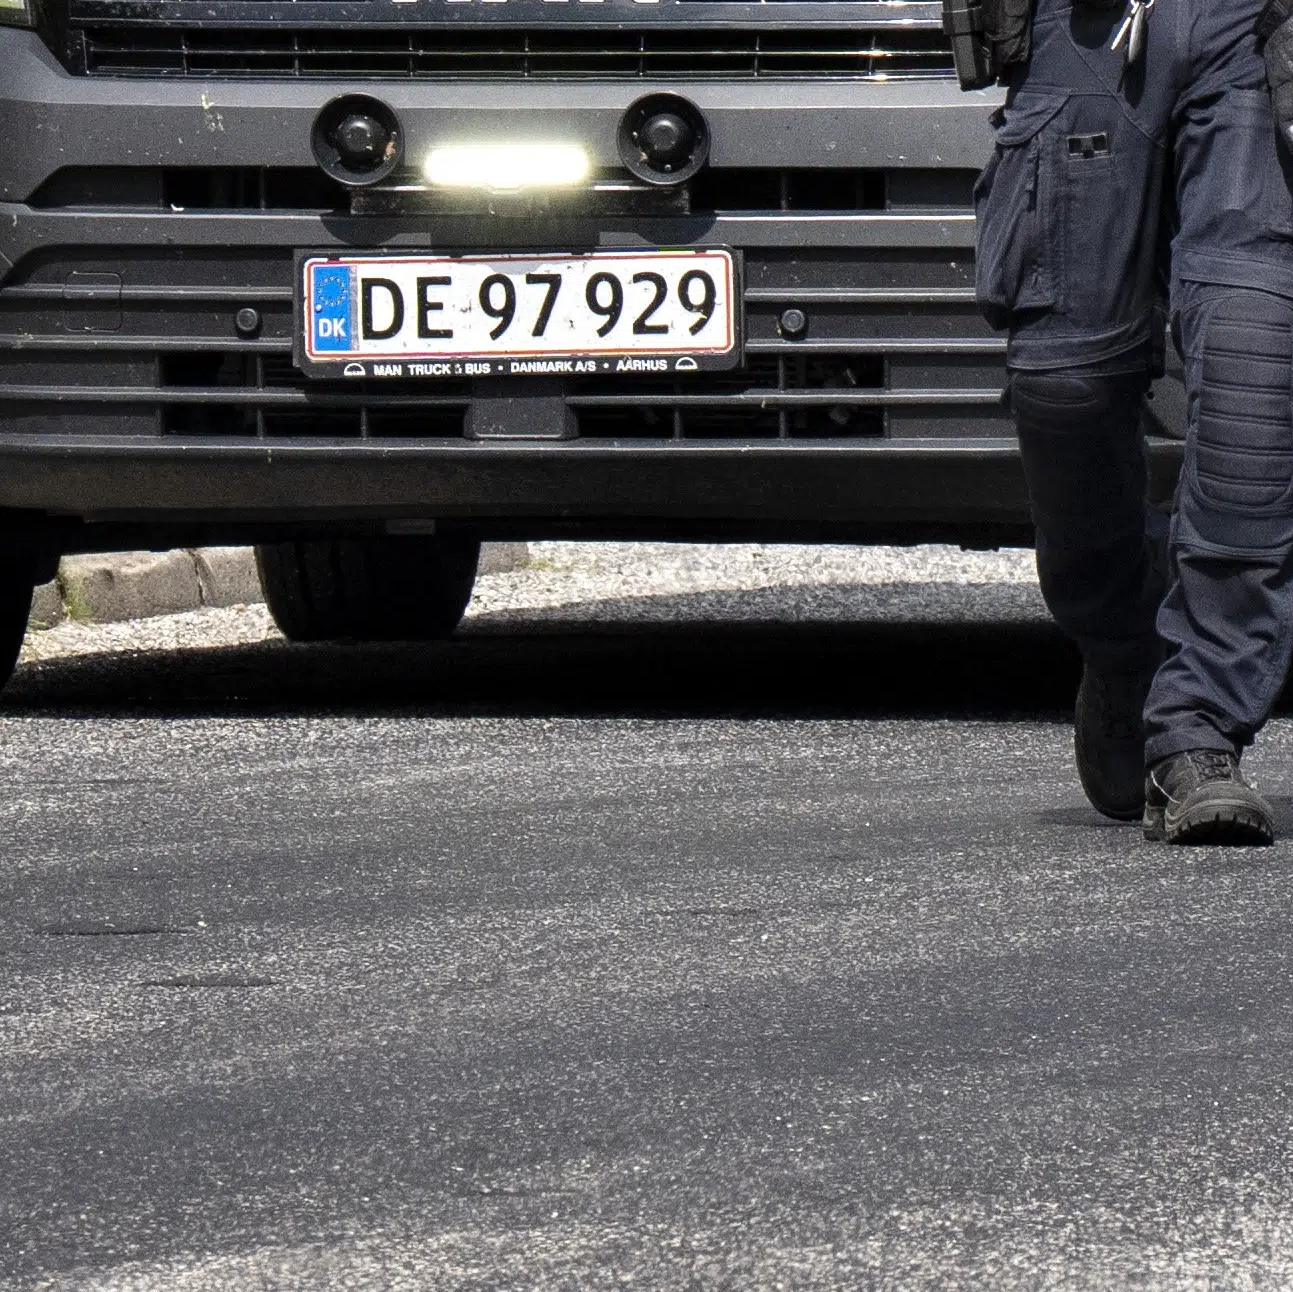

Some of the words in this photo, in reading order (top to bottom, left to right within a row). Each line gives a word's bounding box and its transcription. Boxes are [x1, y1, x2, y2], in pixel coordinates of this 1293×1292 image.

[361, 276, 453, 341] DE
[479, 273, 562, 340] 97
[585, 270, 717, 337] 929
[318, 317, 346, 338] DK
[373, 364, 402, 376] MAN
[408, 363, 451, 375] TRUCK
[465, 363, 491, 374] BUS
[511, 361, 573, 373] DANMARK
[575, 360, 597, 372] A/S
